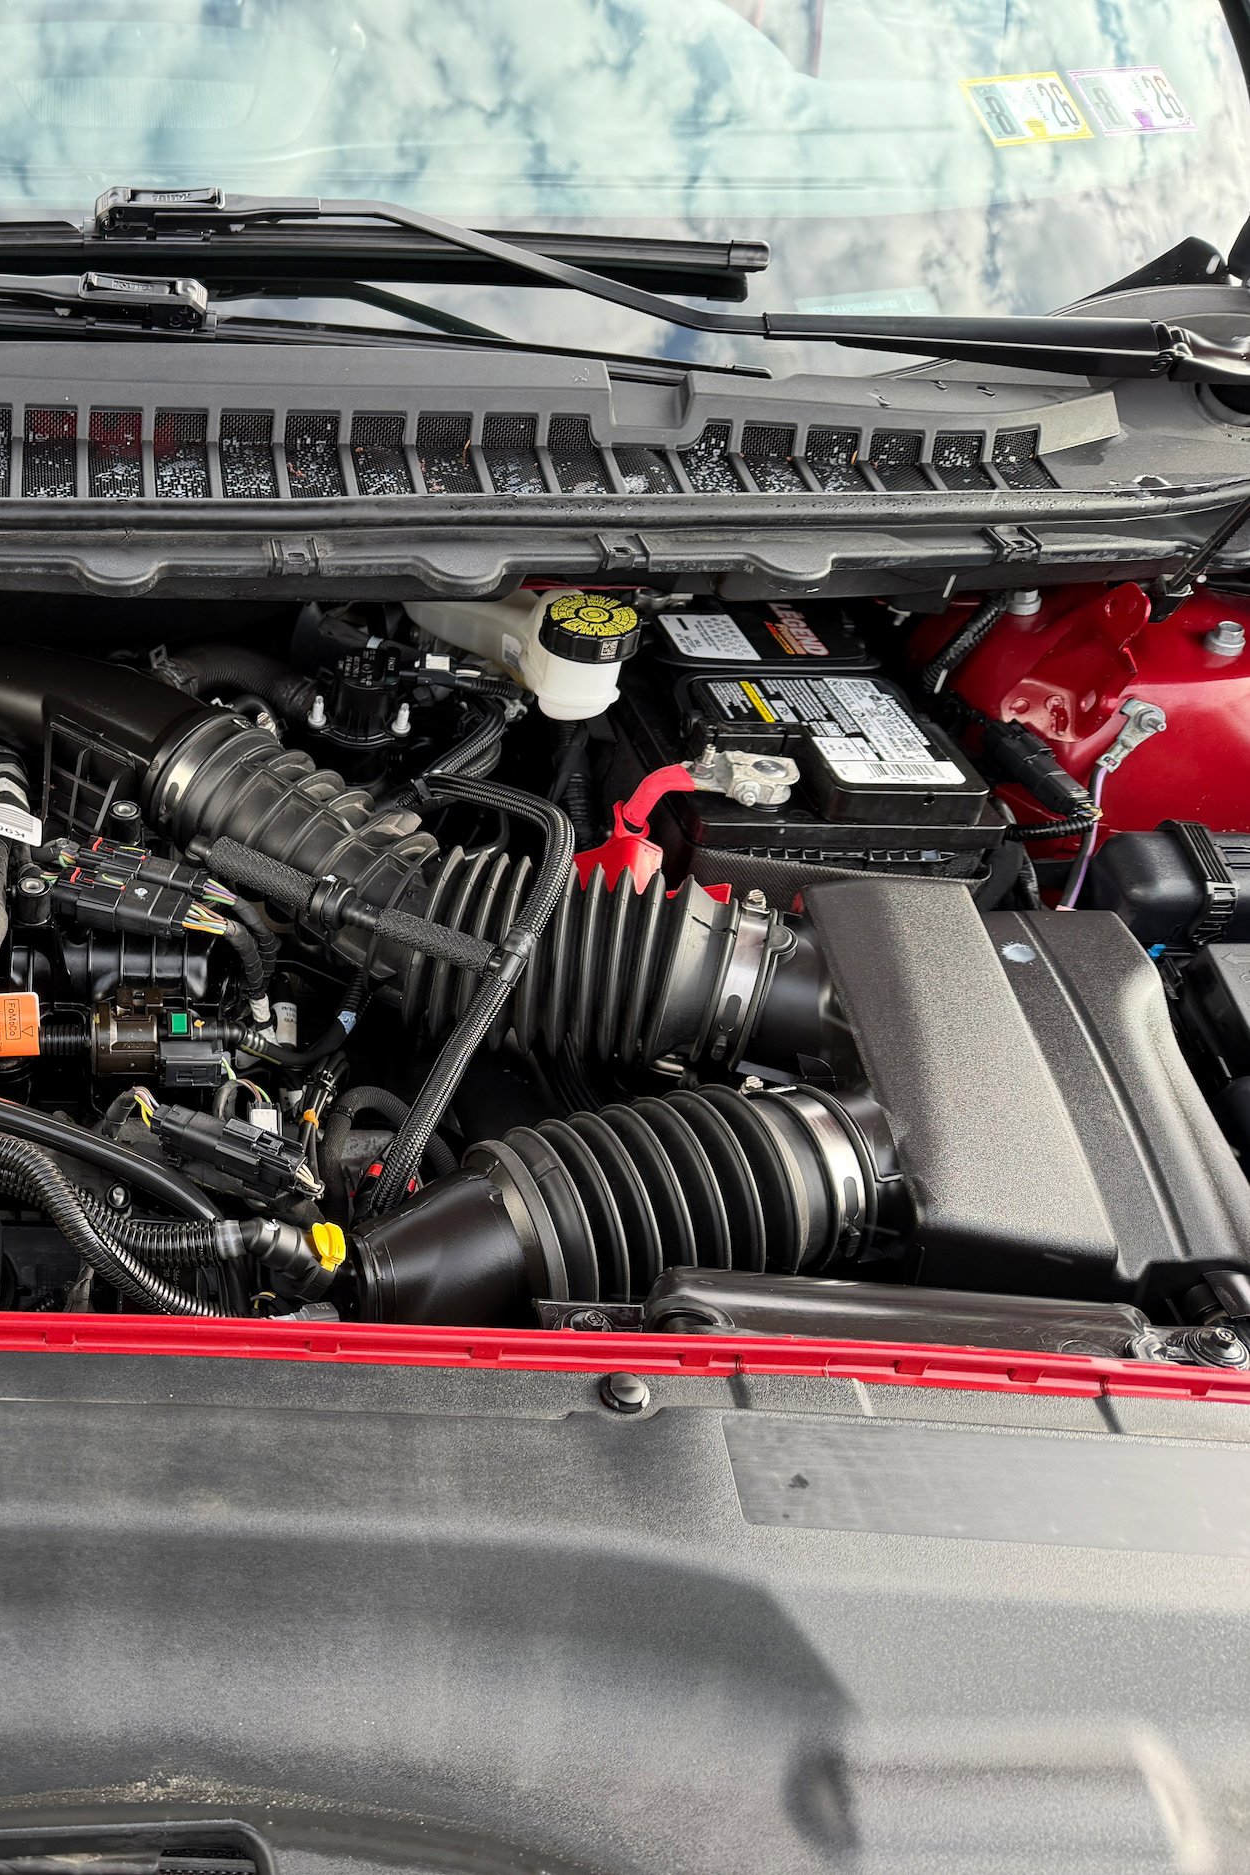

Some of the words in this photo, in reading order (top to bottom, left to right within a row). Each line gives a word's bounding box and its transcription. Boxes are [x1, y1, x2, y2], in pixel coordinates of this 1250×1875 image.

[1037, 82, 1080, 127] 26
[767, 602, 829, 656] LEGEND
[8, 1002, 18, 1037] FoMoCo
